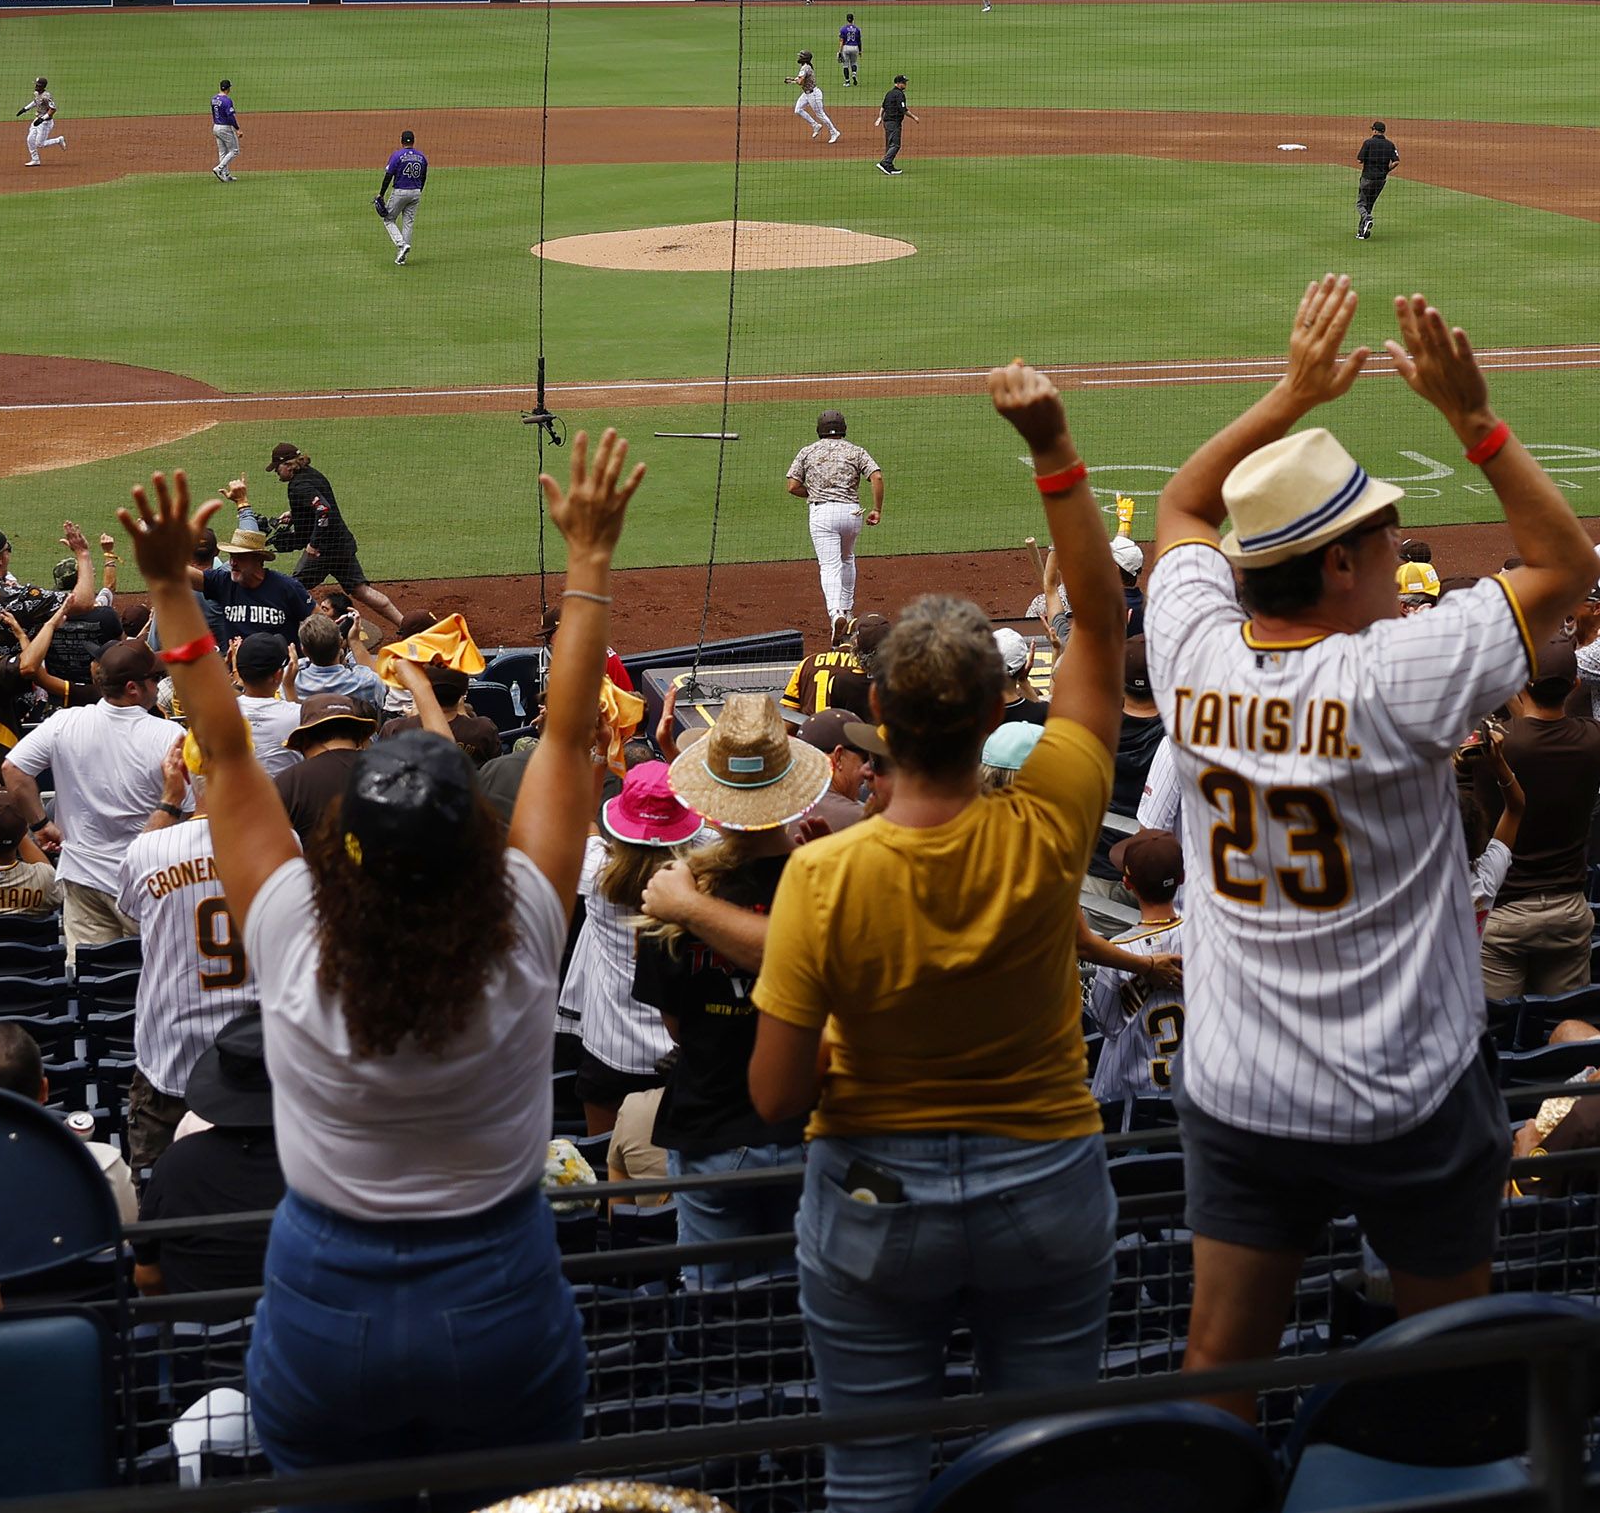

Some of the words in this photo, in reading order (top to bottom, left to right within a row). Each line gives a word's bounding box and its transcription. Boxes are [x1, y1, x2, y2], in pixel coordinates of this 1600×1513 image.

[403, 162, 421, 179] 48
[224, 605, 247, 622] SAN
[249, 606, 286, 625] DIEGO
[1173, 688, 1292, 756] TATIS
[1299, 698, 1362, 760] JR.
[1197, 765, 1355, 911] 23
[194, 895, 249, 992] 9
